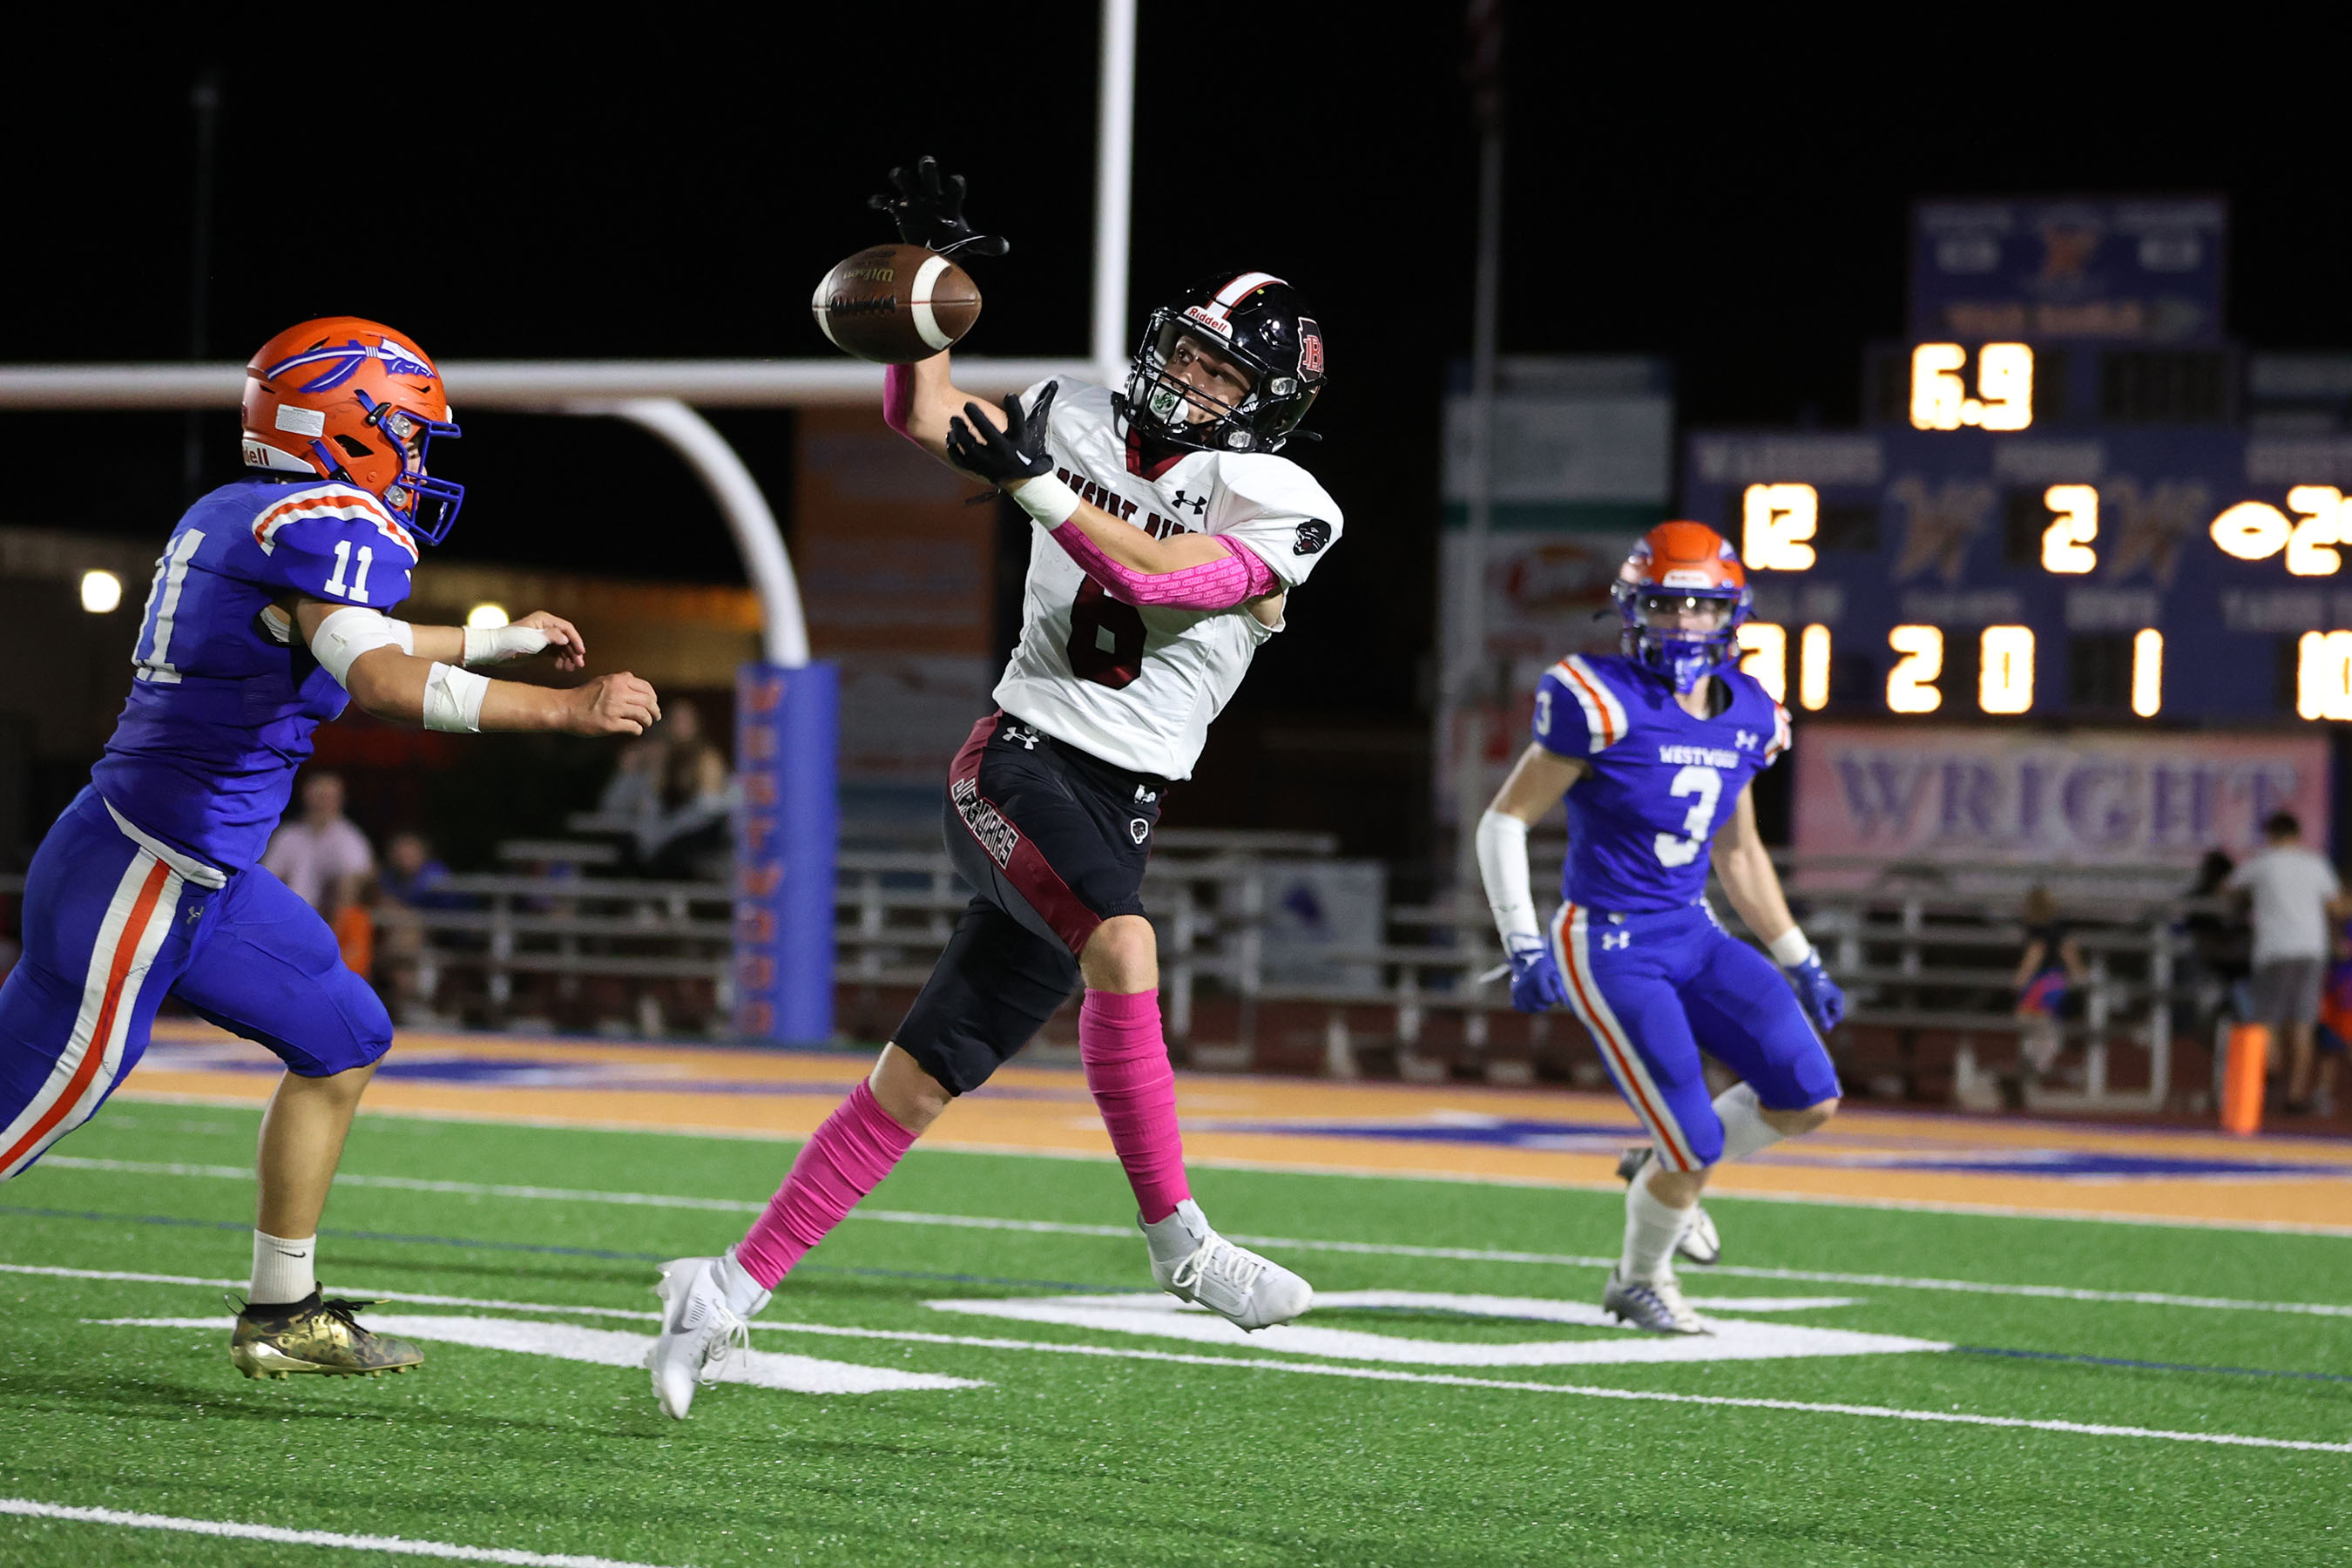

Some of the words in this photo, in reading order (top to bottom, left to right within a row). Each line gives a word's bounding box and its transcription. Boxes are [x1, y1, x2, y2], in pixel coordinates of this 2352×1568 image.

[1188, 308, 1228, 333] Riddell
[1909, 342, 2033, 430] 6.9
[323, 540, 374, 604] 11
[1742, 483, 1818, 571] 12
[2042, 484, 2099, 574] 2
[131, 528, 206, 684] 11
[1066, 574, 1147, 691] 6
[1536, 690, 1552, 736] 3
[2132, 627, 2164, 717] 1
[1654, 765, 1722, 868] 3
[1830, 747, 2298, 850] WRIGHT
